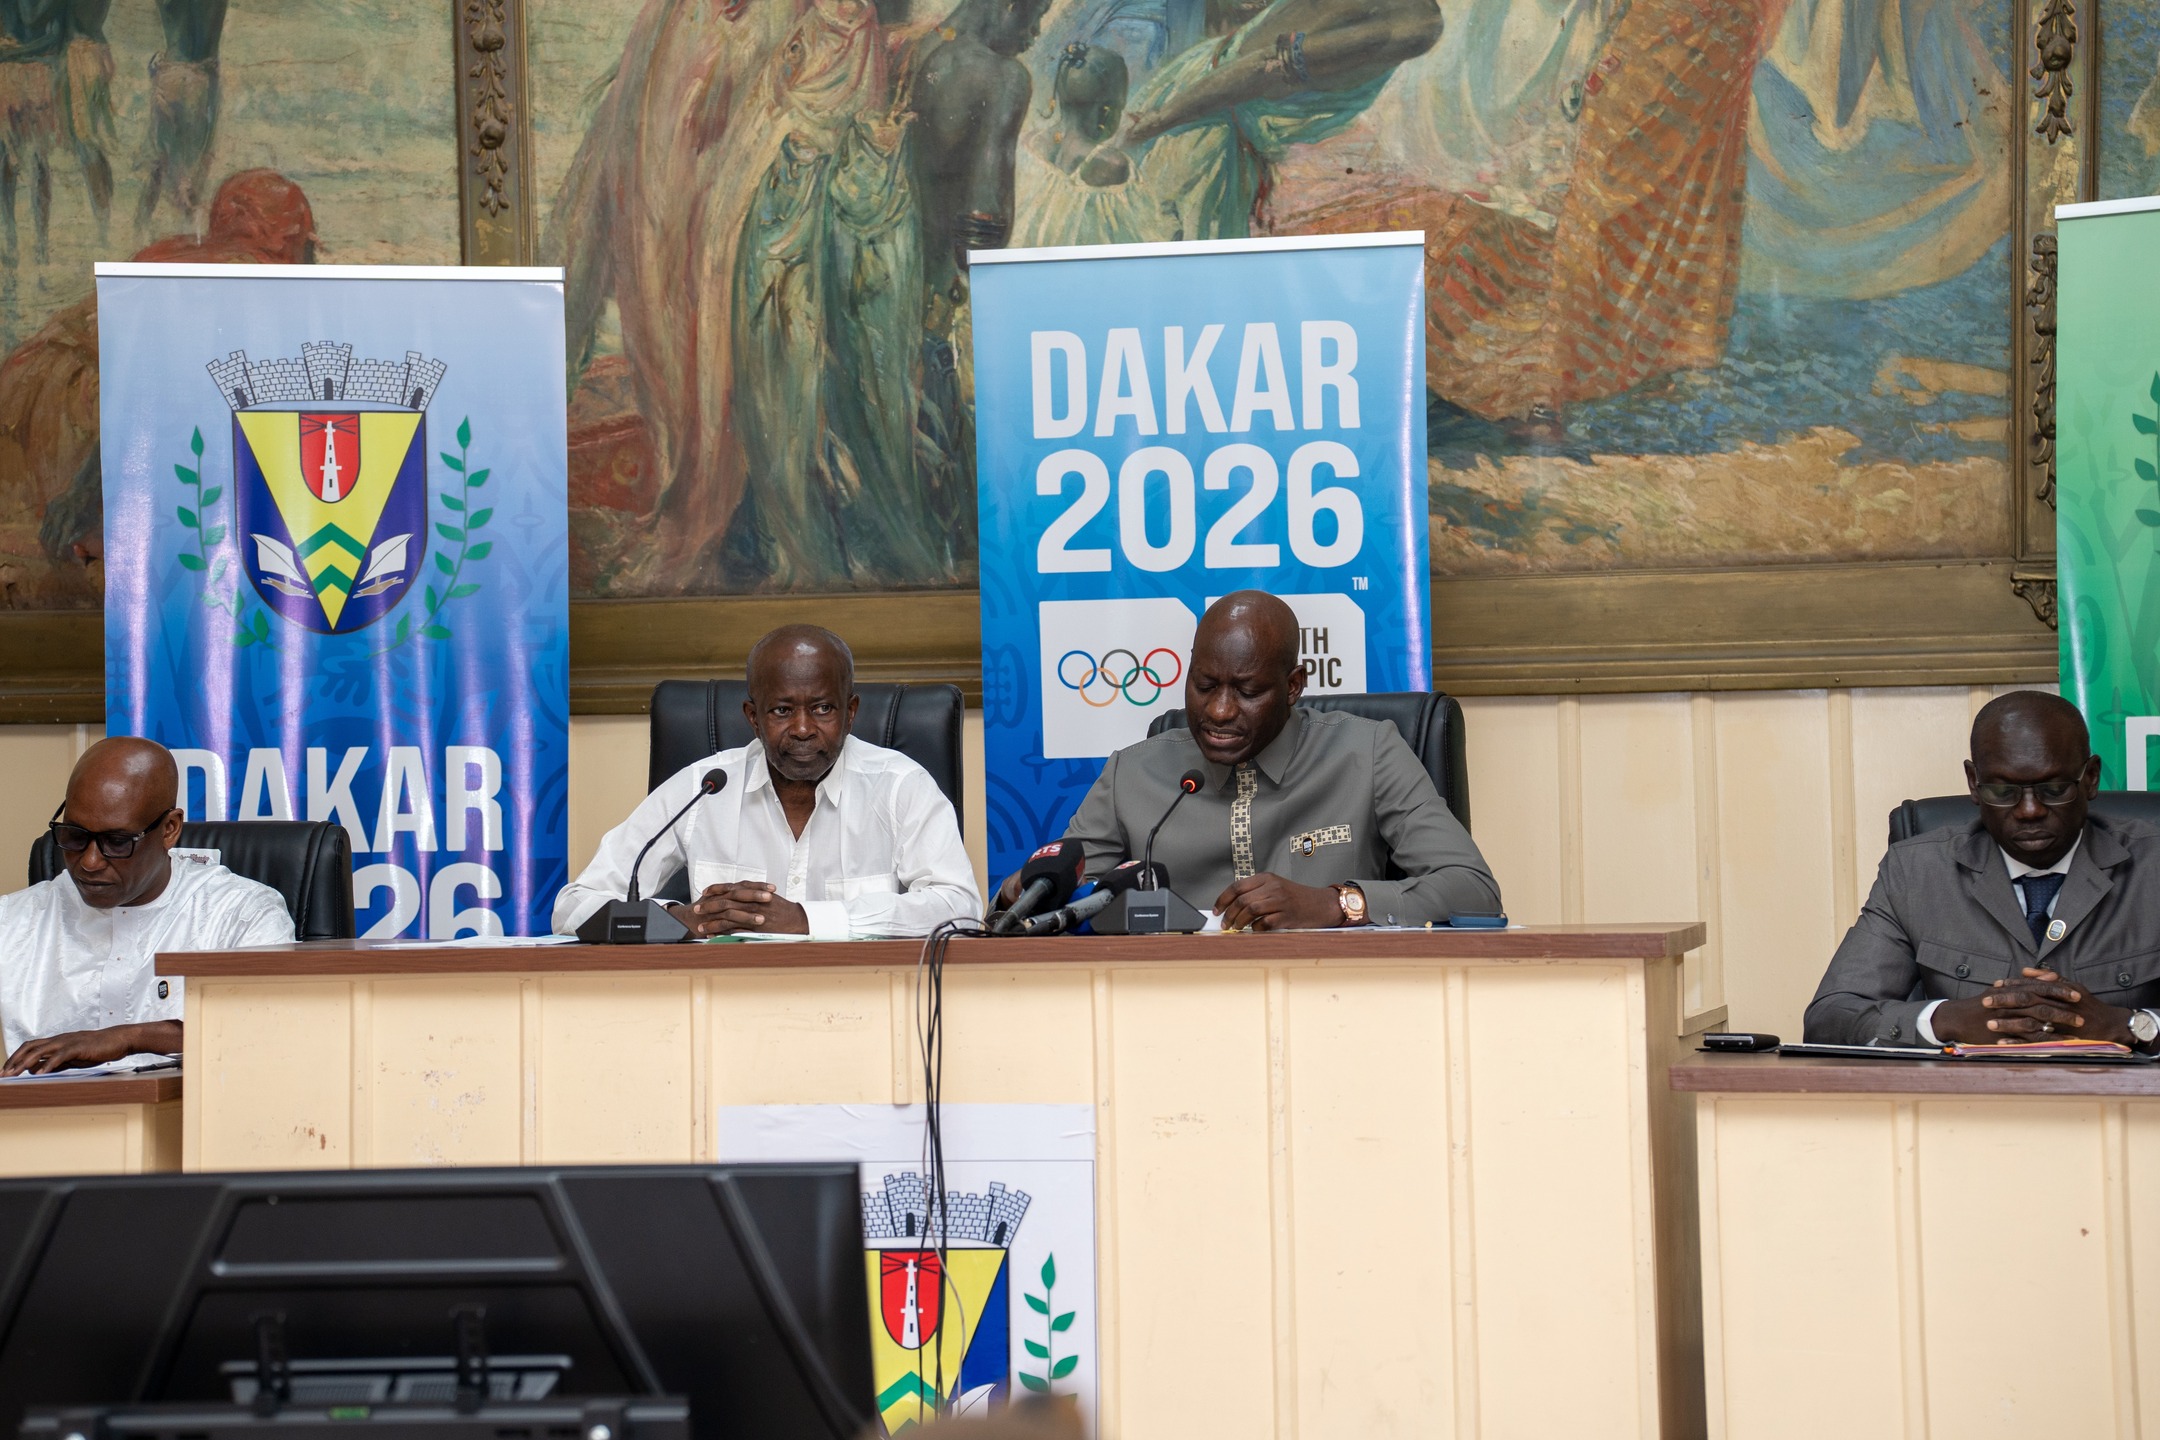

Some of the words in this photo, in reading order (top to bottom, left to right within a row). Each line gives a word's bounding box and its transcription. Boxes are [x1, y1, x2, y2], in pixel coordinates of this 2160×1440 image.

[1031, 320, 1361, 439] DAKAR
[1036, 441, 1364, 573] 2026
[1352, 576, 1369, 590] TM
[1299, 627, 1329, 654] TH
[1302, 657, 1342, 688] PIC
[1030, 844, 1061, 859] RTS
[352, 862, 505, 939] 26
